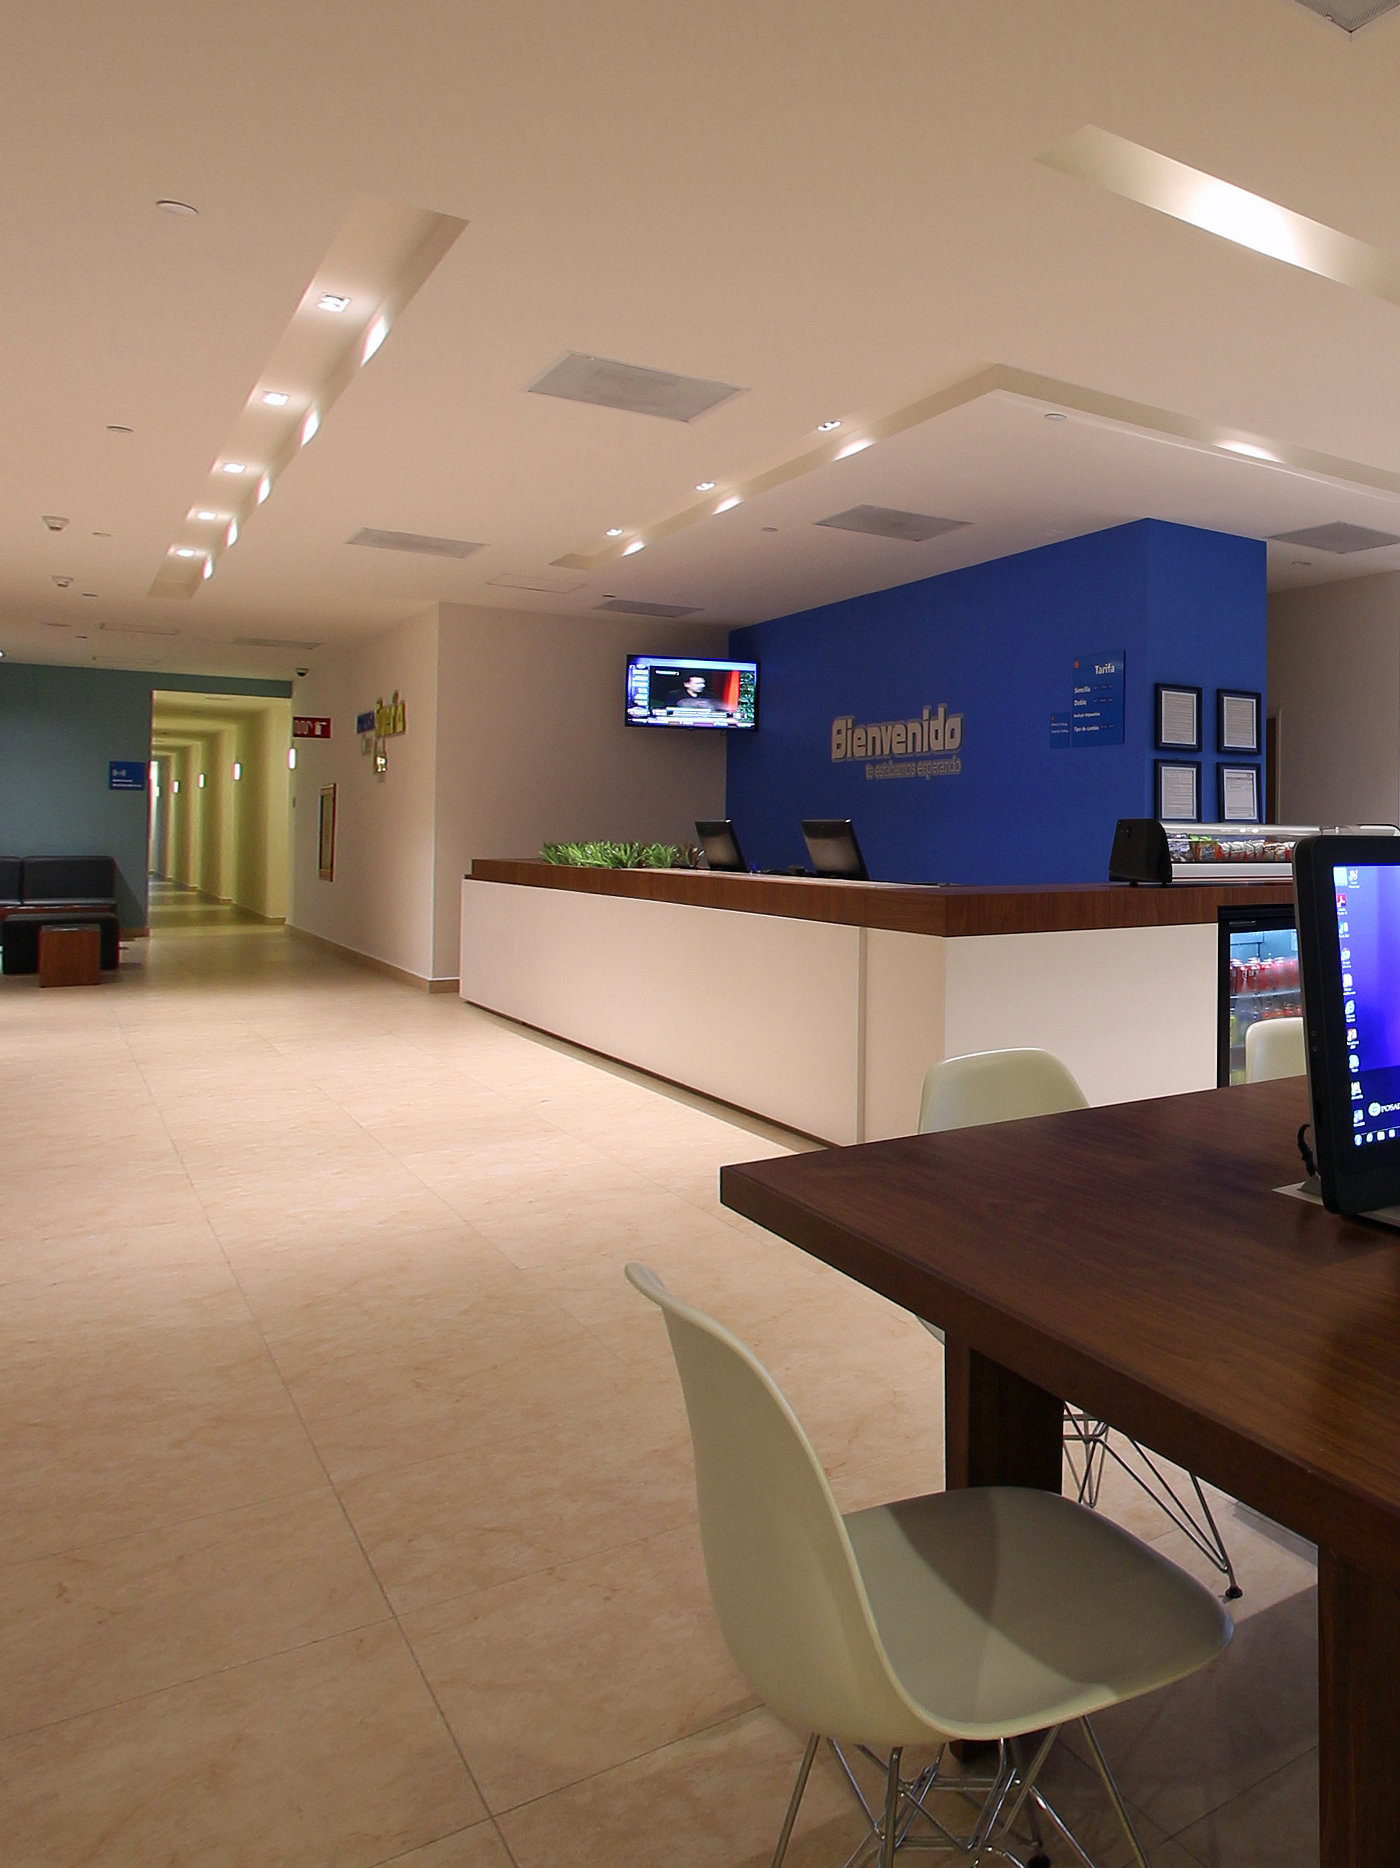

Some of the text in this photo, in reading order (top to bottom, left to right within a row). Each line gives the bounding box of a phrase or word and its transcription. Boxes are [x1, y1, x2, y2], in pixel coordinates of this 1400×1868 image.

[1095, 663, 1115, 674] Tarifa
[832, 704, 962, 761] Bienvenido
[917, 755, 962, 780] esperando
